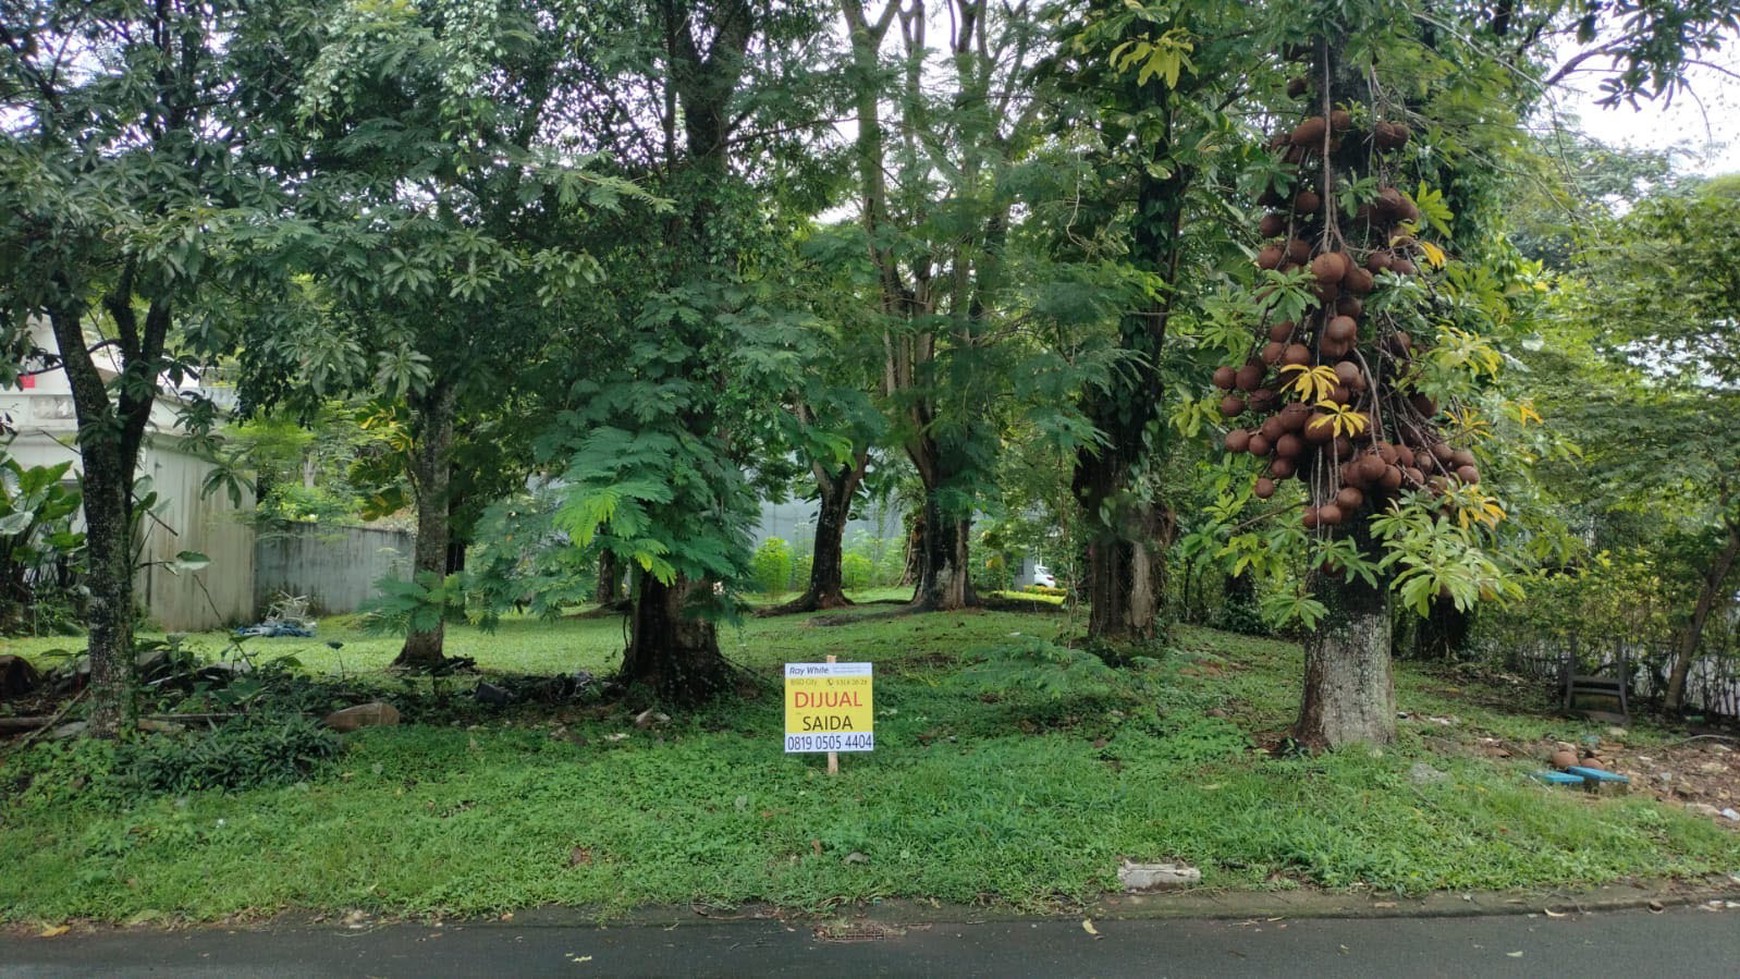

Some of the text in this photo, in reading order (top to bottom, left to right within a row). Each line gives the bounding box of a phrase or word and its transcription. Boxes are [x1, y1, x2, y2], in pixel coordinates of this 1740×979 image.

[789, 666, 829, 675] Ray White
[795, 692, 863, 708] DIJUAL
[803, 716, 853, 731] SAIDA
[788, 735, 872, 750] 0819 0505 4404
